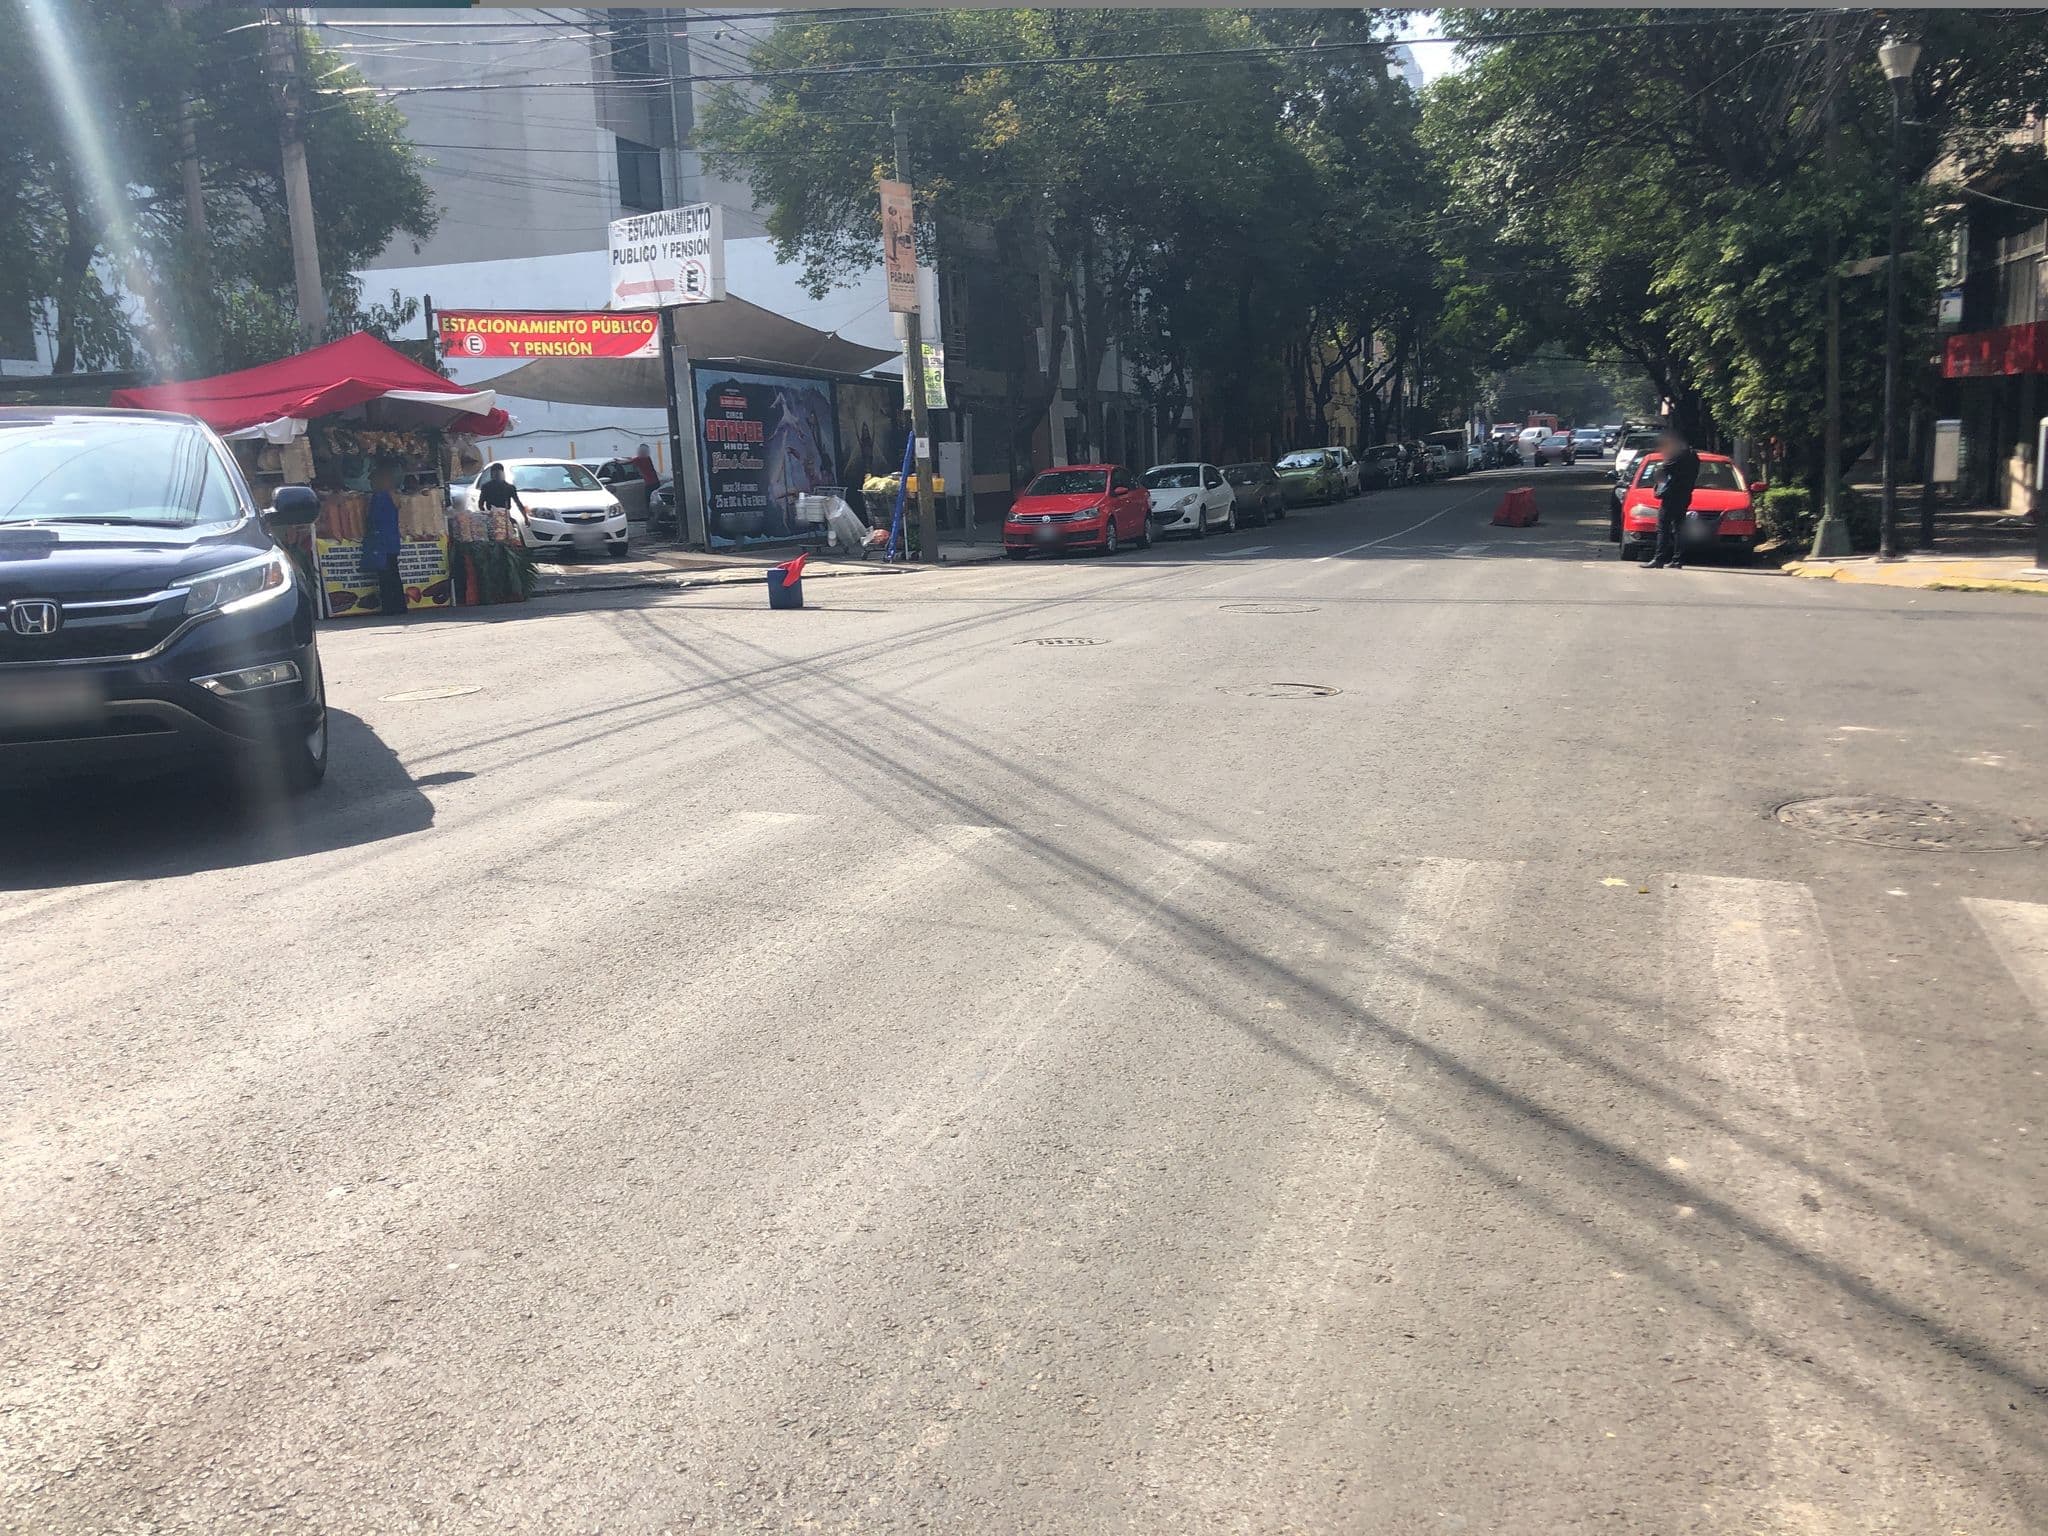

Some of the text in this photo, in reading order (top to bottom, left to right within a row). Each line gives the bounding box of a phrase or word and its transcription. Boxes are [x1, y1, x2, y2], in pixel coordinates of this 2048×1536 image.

[628, 206, 711, 241] ESTACIONAMIENTO
[613, 235, 710, 266] PUBLICO Y PENSIÓN
[442, 315, 653, 334] ESTACIONAMIENTO PÚBLICO
[469, 338, 481, 351] E
[510, 337, 593, 356] Y PENSIÓN
